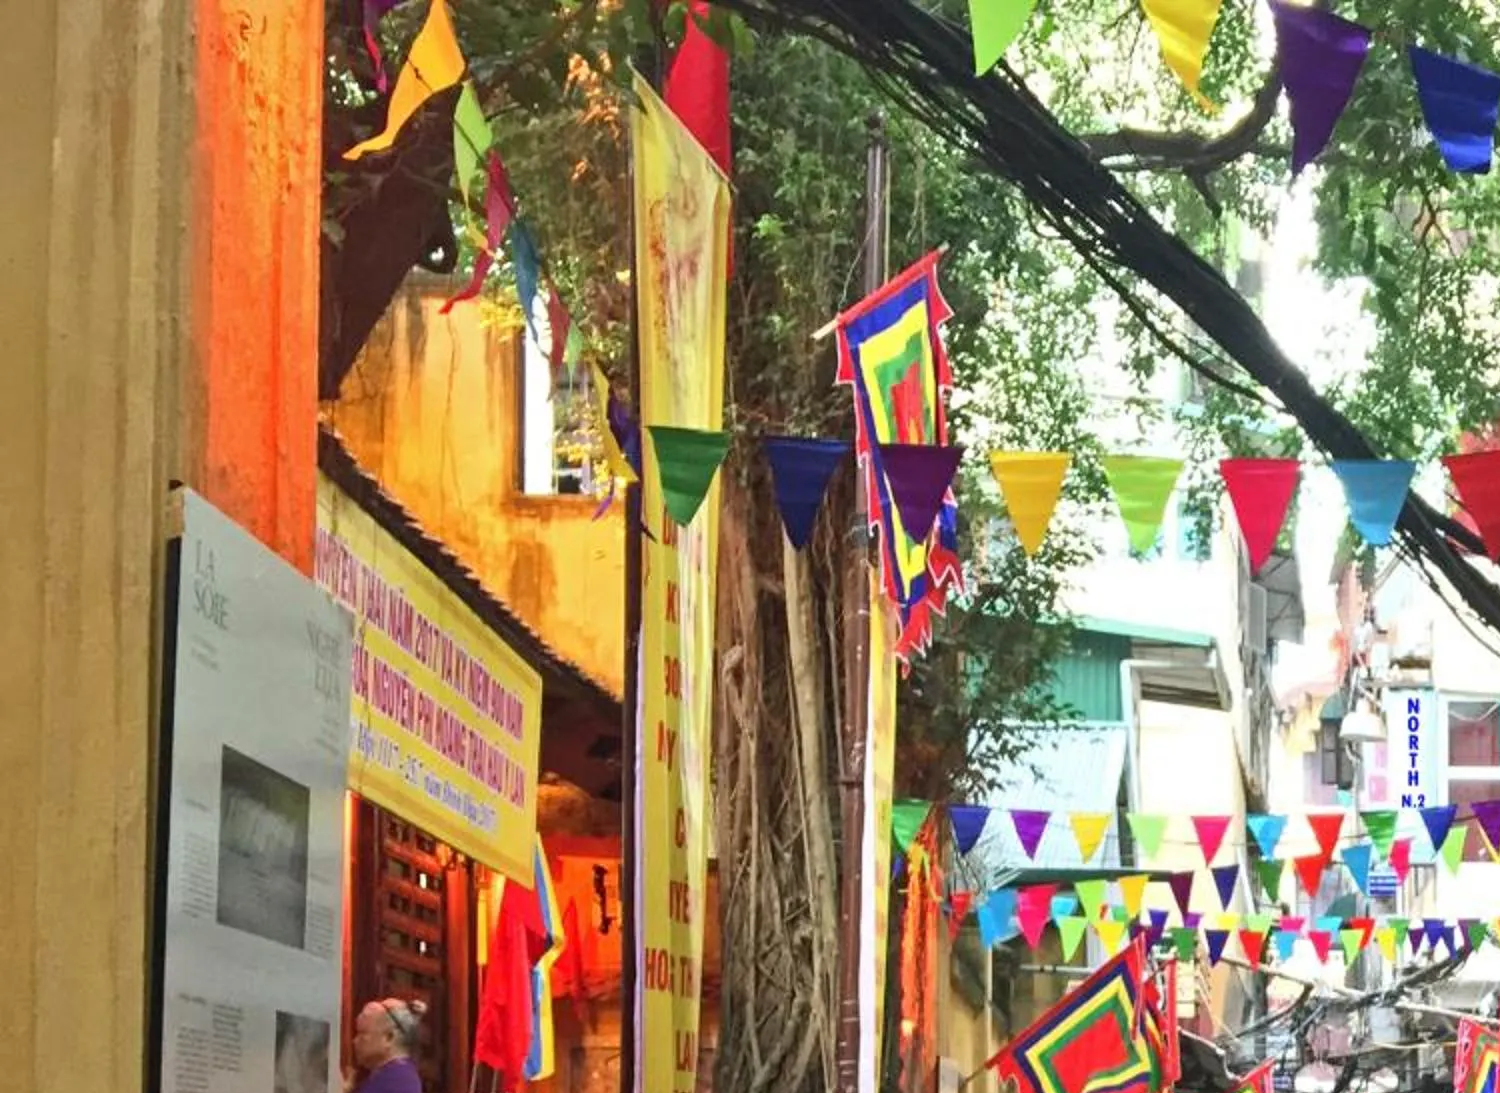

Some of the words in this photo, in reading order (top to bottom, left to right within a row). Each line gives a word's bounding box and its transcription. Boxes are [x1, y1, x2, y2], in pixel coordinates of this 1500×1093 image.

[414, 610, 438, 674] 2017
[1407, 697, 1421, 787] NORTH
[1401, 794, 1426, 809] N.2
